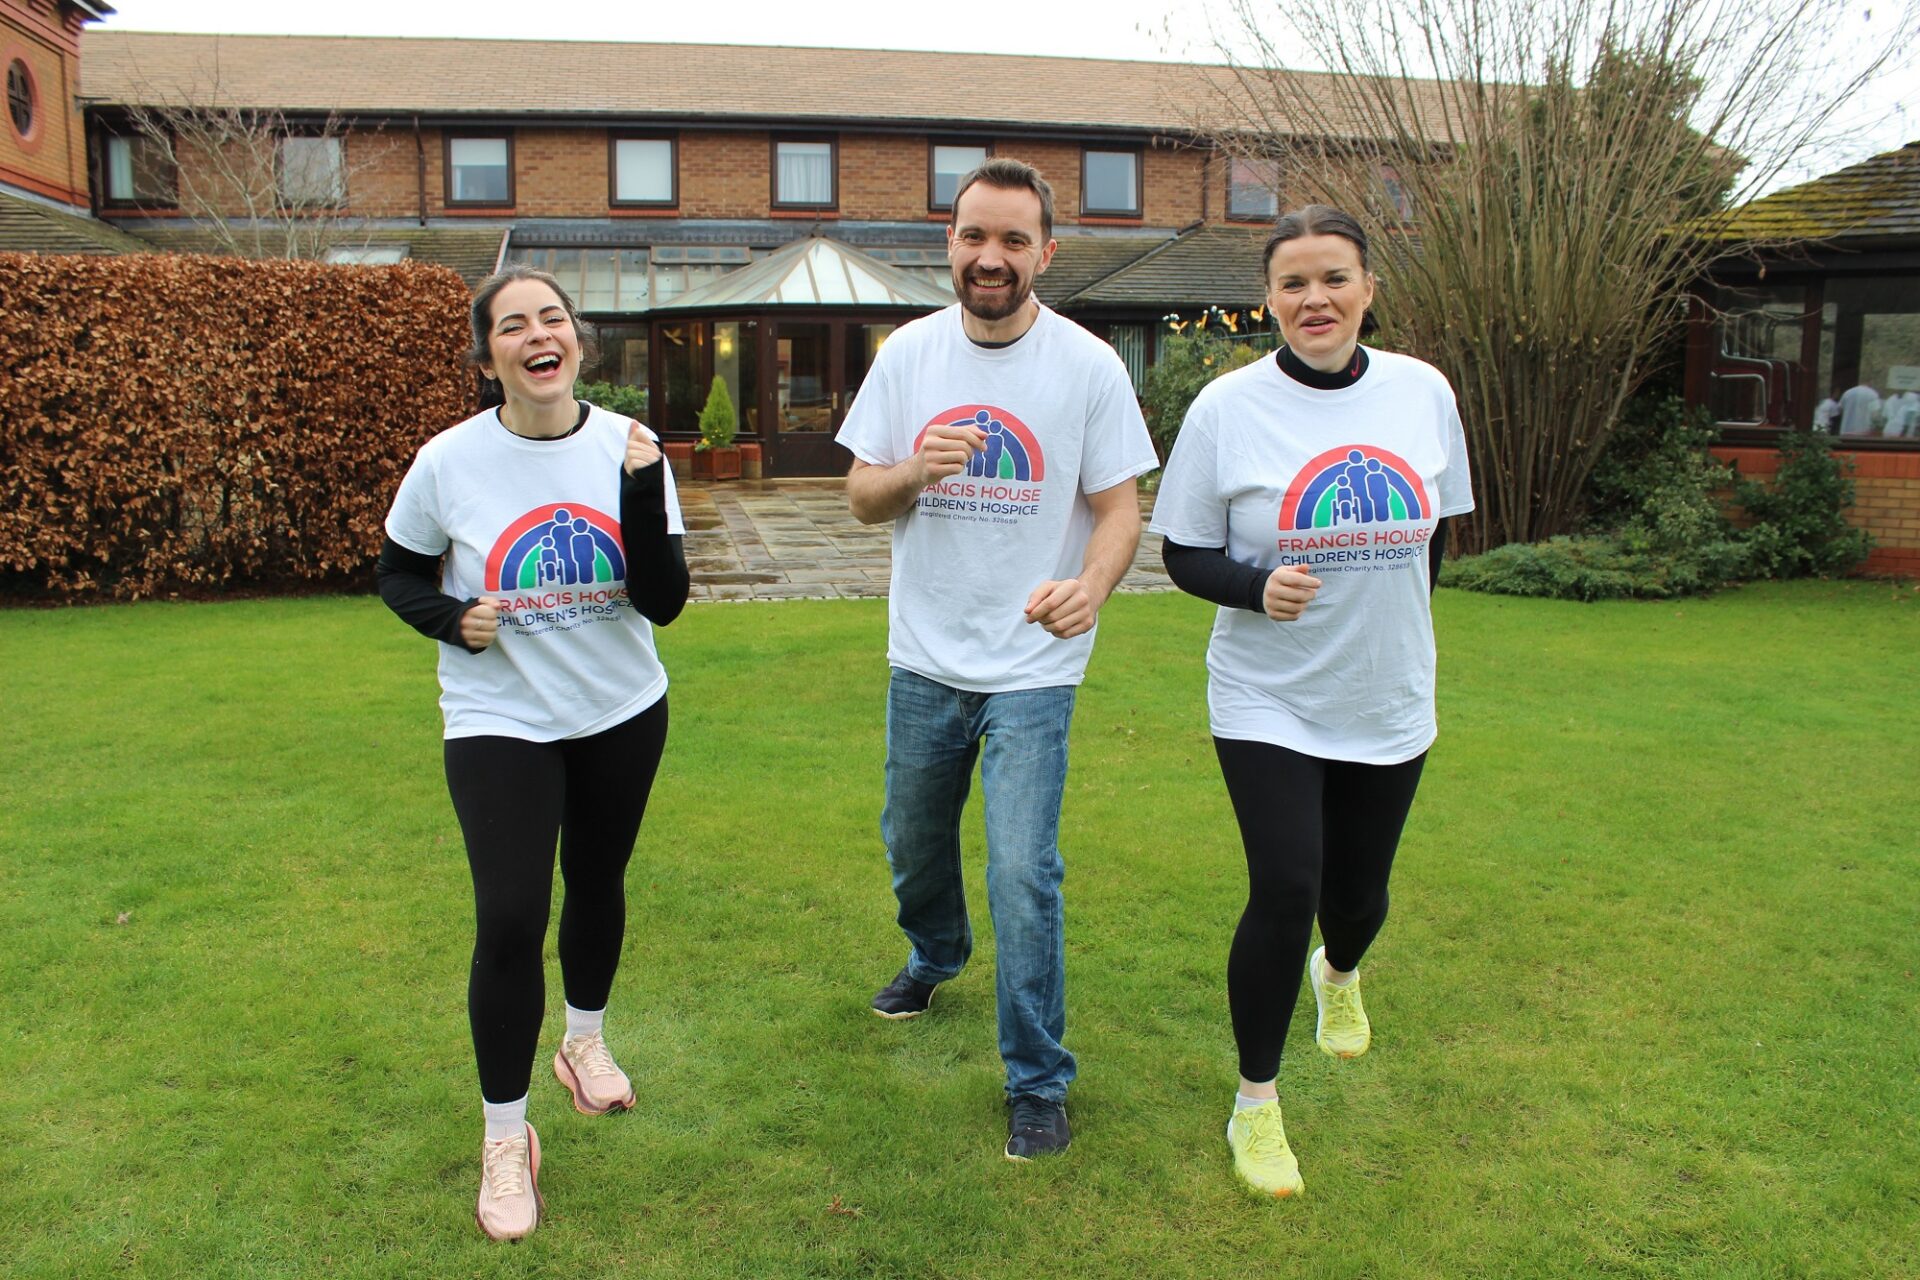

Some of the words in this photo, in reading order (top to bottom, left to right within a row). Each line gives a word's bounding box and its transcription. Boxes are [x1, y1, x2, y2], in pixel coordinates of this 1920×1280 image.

[921, 481, 975, 498] ANCIS
[981, 486, 1042, 502] HOUSE
[915, 497, 977, 512] HILDREN'S
[980, 502, 1039, 516] HOSPICE
[920, 511, 951, 520] Registered
[953, 513, 977, 522] Charity
[1278, 531, 1367, 552] FRANCIS
[1374, 528, 1431, 545] HOUSE
[1281, 550, 1371, 566] CHILDREN'S
[1374, 544, 1424, 560] HOSPICE
[1308, 566, 1342, 574] egistered
[1344, 564, 1371, 574] Charity
[498, 591, 573, 613] RANCIS
[579, 588, 631, 604] HOUS
[515, 626, 554, 637] Registered
